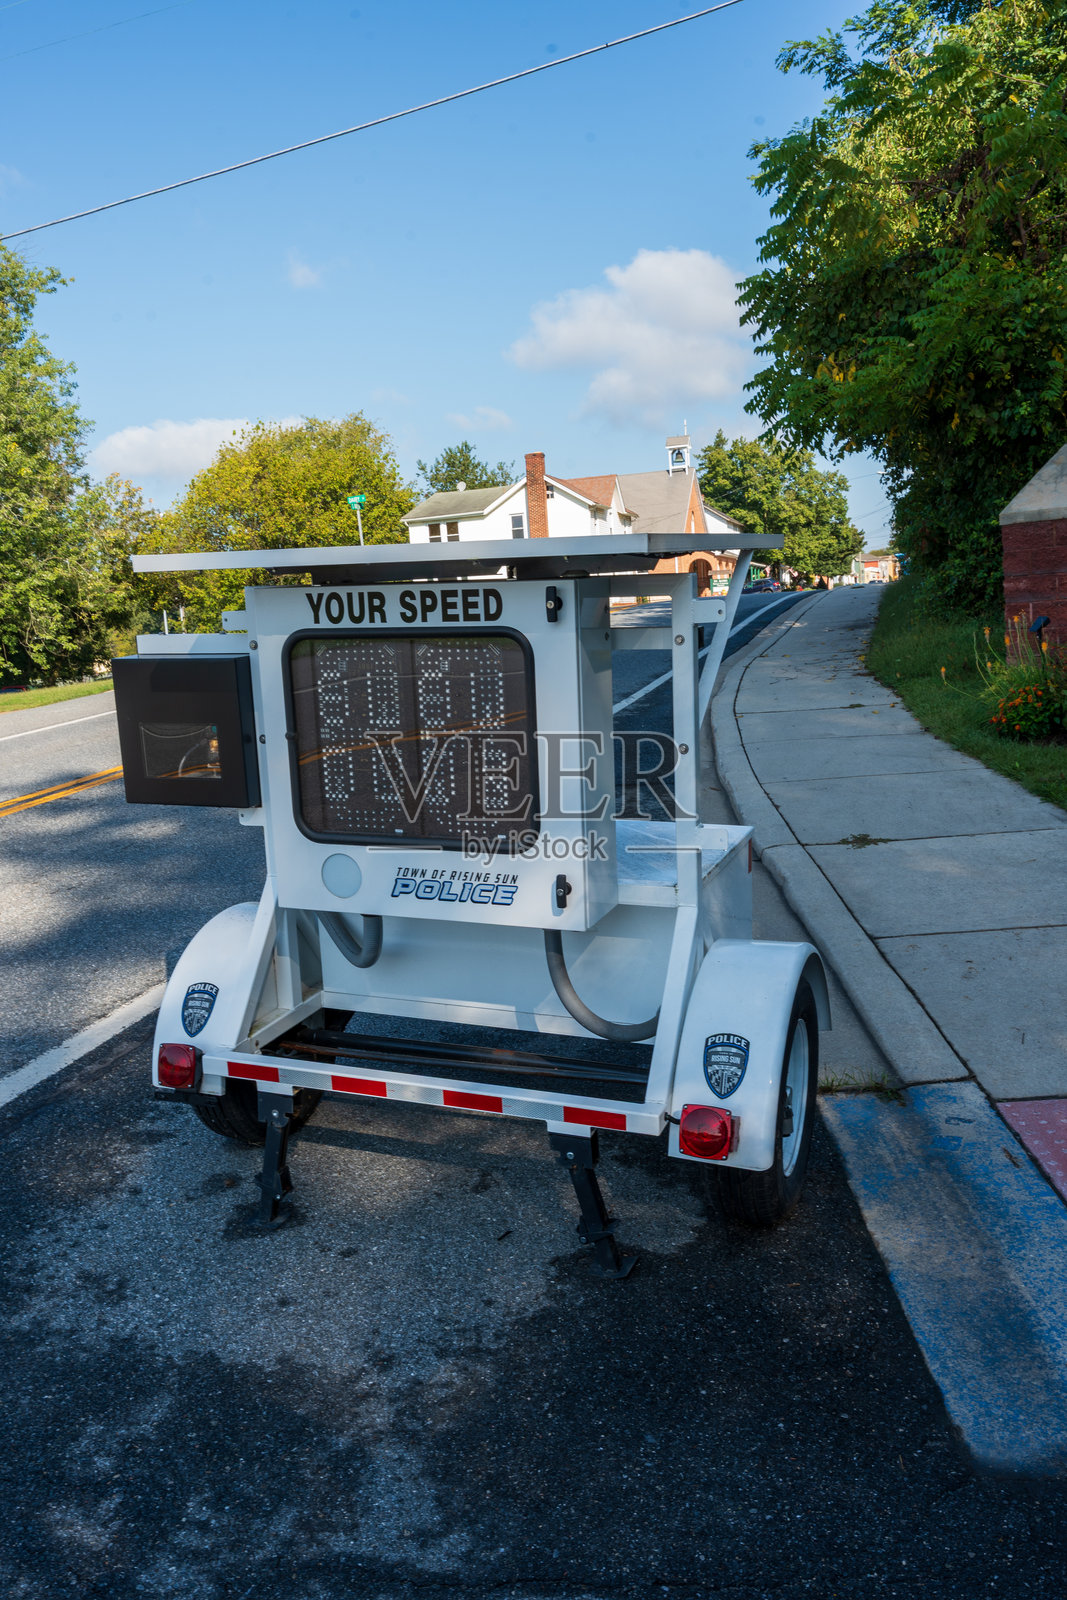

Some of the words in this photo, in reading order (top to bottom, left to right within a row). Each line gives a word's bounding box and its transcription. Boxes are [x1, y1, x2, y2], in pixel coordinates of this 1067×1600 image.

[306, 591, 387, 625] YOUR
[400, 588, 503, 623] SPEED
[396, 867, 427, 879] TOWN
[431, 869, 446, 880] OF
[450, 870, 491, 882] RISING
[494, 873, 519, 884] SUN
[391, 878, 518, 905] POLICE
[188, 984, 217, 995] POLICE
[708, 1035, 748, 1049] POLICE
